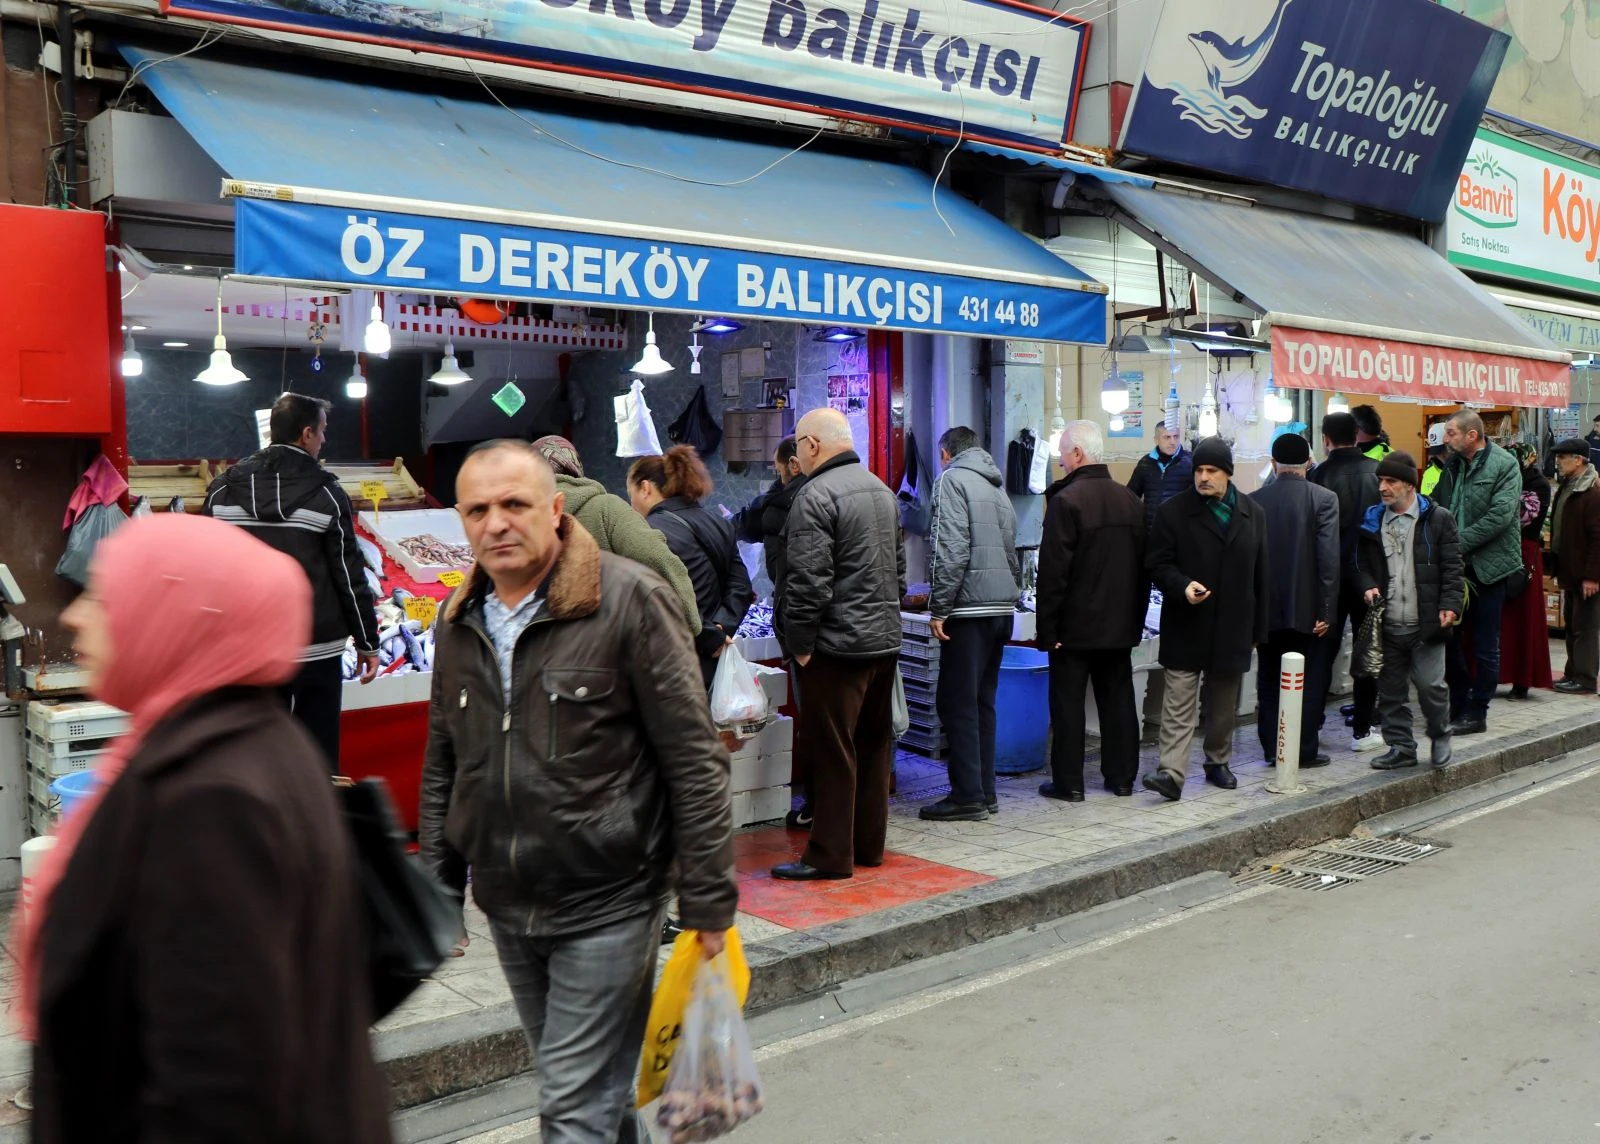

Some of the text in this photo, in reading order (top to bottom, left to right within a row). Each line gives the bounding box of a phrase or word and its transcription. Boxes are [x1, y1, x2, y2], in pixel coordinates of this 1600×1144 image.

[762, 0, 1041, 101] balıkçısı
[1290, 40, 1449, 140] Topaloğlu
[1273, 115, 1421, 176] BALIKÇILIK
[1459, 174, 1514, 219] Banvit
[340, 215, 1039, 328] ÖZ DEREKÖY BALIKÇISI 431 44 88
[1461, 232, 1510, 254] Satış Noktası
[1521, 314, 1572, 343] ÖYÜM
[1284, 341, 1415, 384] TOPALOĞLU
[1421, 356, 1521, 398] BALIKÇILIK
